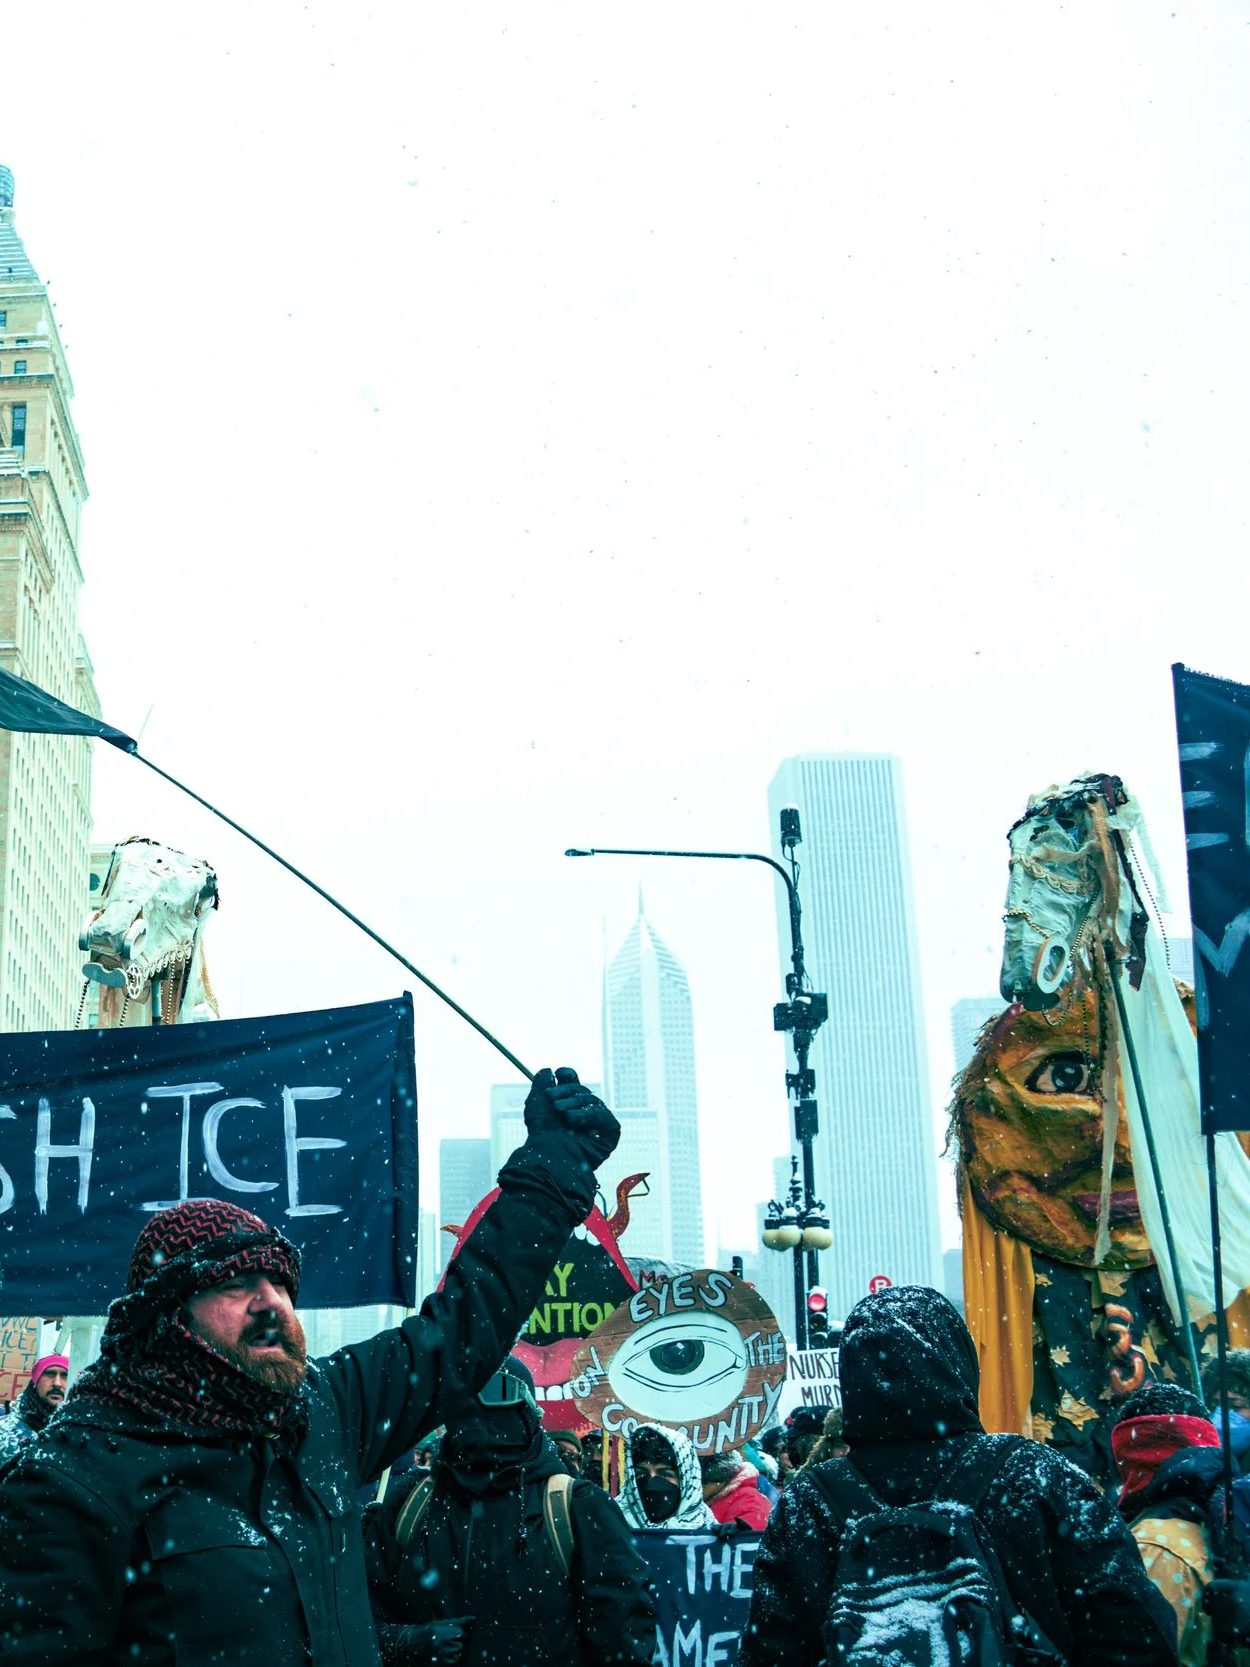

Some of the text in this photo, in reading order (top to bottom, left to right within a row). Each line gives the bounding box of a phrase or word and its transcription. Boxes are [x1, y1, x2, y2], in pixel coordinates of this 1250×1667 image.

[140, 1081, 348, 1217] ICE
[527, 1302, 618, 1334] NTION
[629, 1272, 733, 1323] EYES
[572, 1344, 608, 1399] ON
[743, 1331, 785, 1368] THE
[601, 1377, 786, 1454] COUNITY
[665, 1535, 760, 1598] THE
